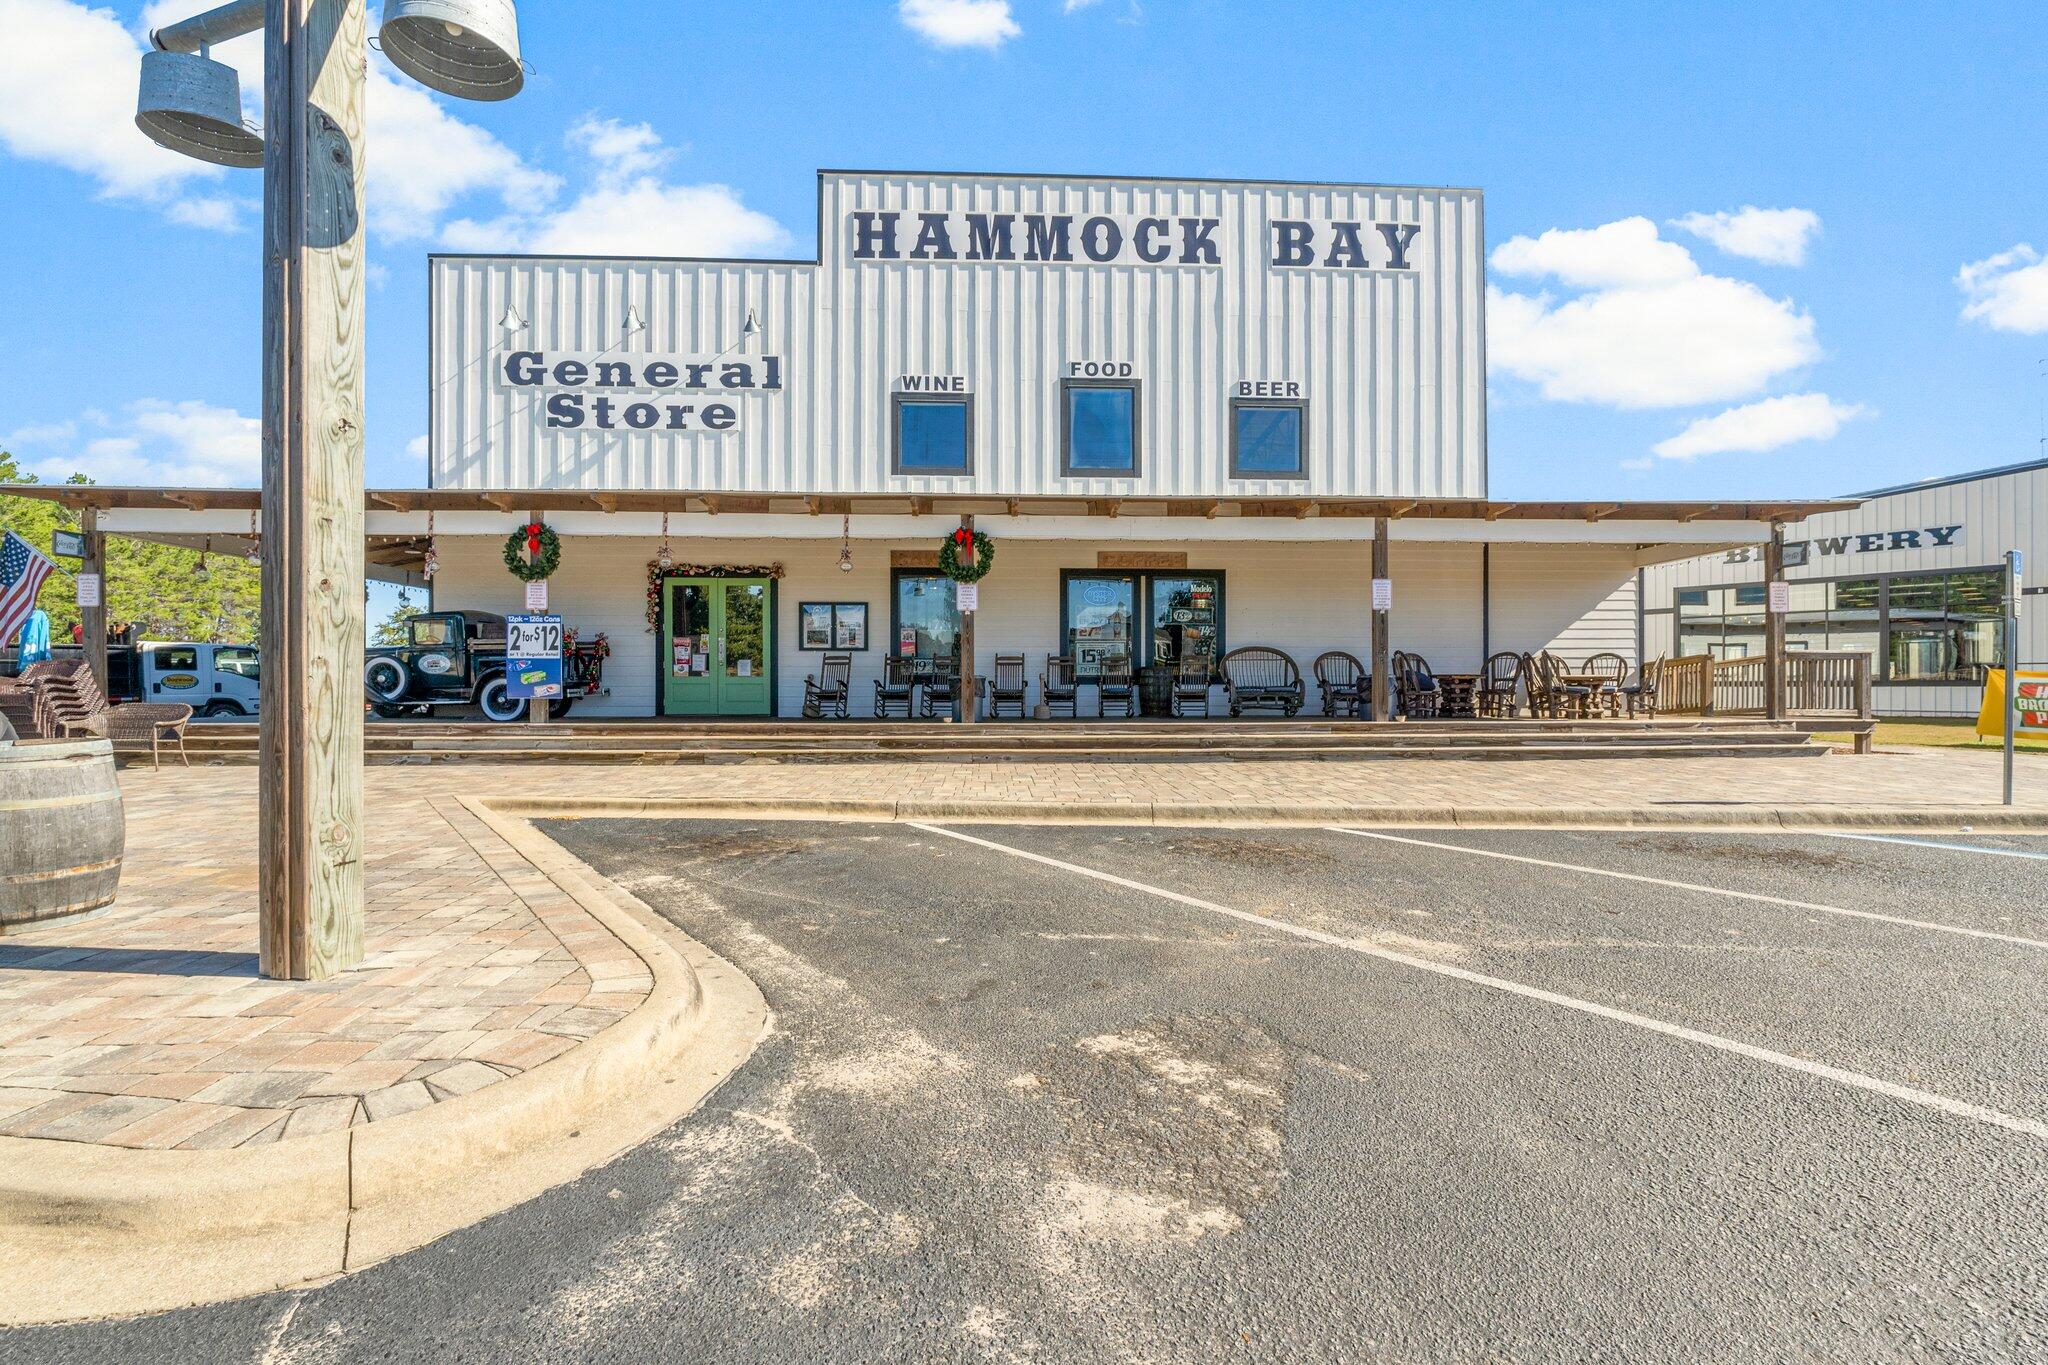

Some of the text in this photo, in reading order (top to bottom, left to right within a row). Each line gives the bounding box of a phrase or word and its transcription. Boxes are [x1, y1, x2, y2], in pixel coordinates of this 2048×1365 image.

[853, 212, 1421, 270] HAMMOCK BAY
[503, 350, 783, 389] General
[1070, 361, 1133, 377] FOOD
[901, 375, 965, 391] WINE
[1239, 380, 1301, 397] BEER
[546, 393, 737, 430] Store
[1723, 524, 1963, 565] BWERY
[1190, 584, 1213, 593] Modelo
[510, 625, 560, 651] 2 for $12
